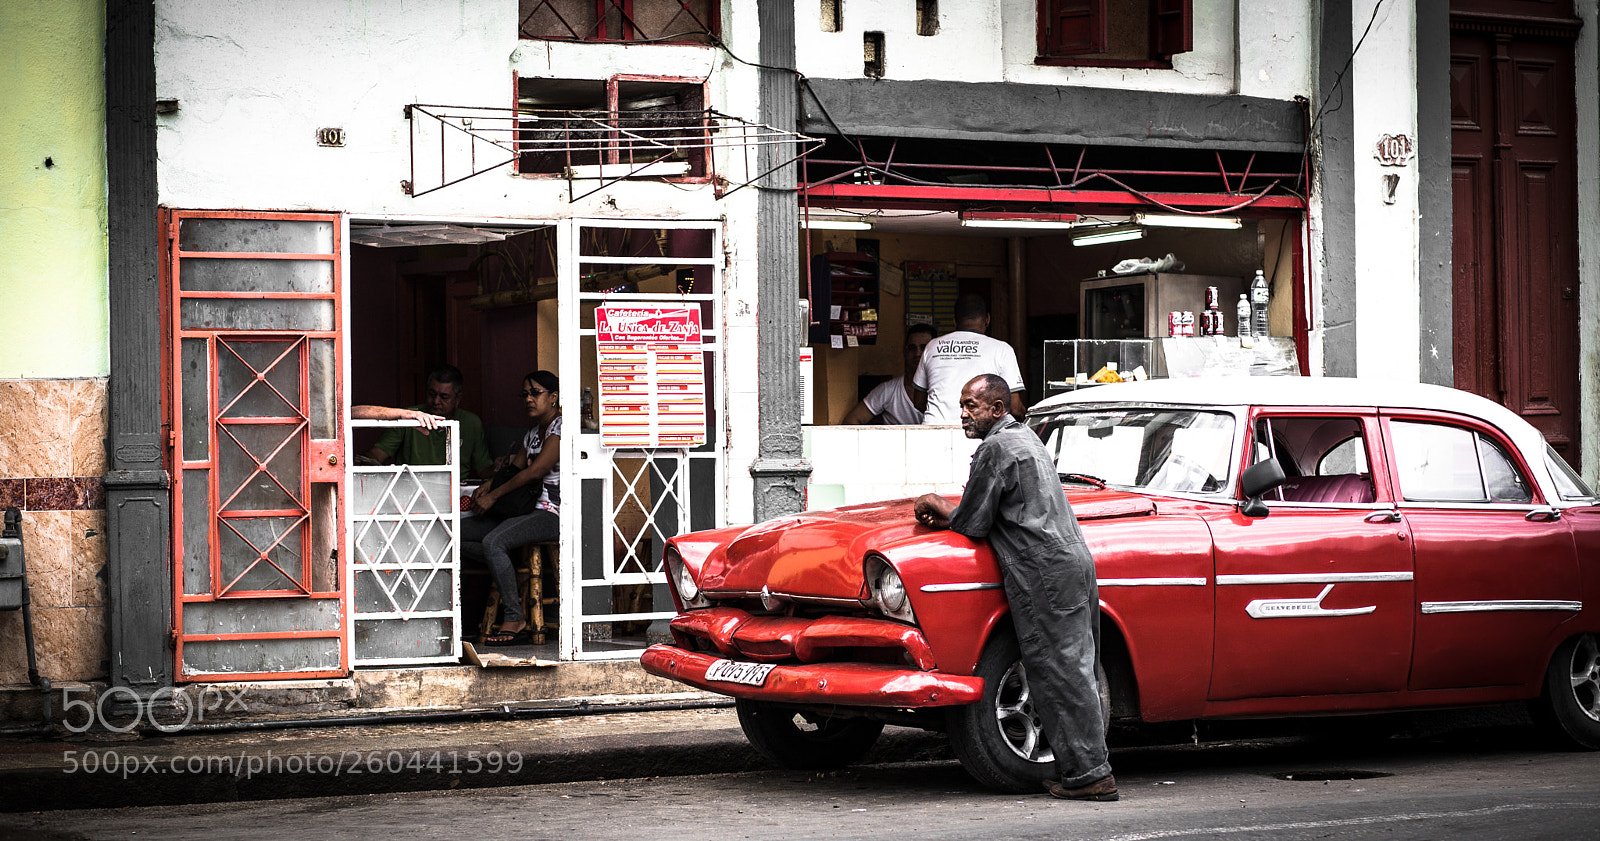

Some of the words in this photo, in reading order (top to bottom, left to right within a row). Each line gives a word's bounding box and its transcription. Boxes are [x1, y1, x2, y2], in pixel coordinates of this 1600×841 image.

[322, 129, 343, 144] 101
[1383, 137, 1406, 159] 101
[936, 340, 978, 353] valores
